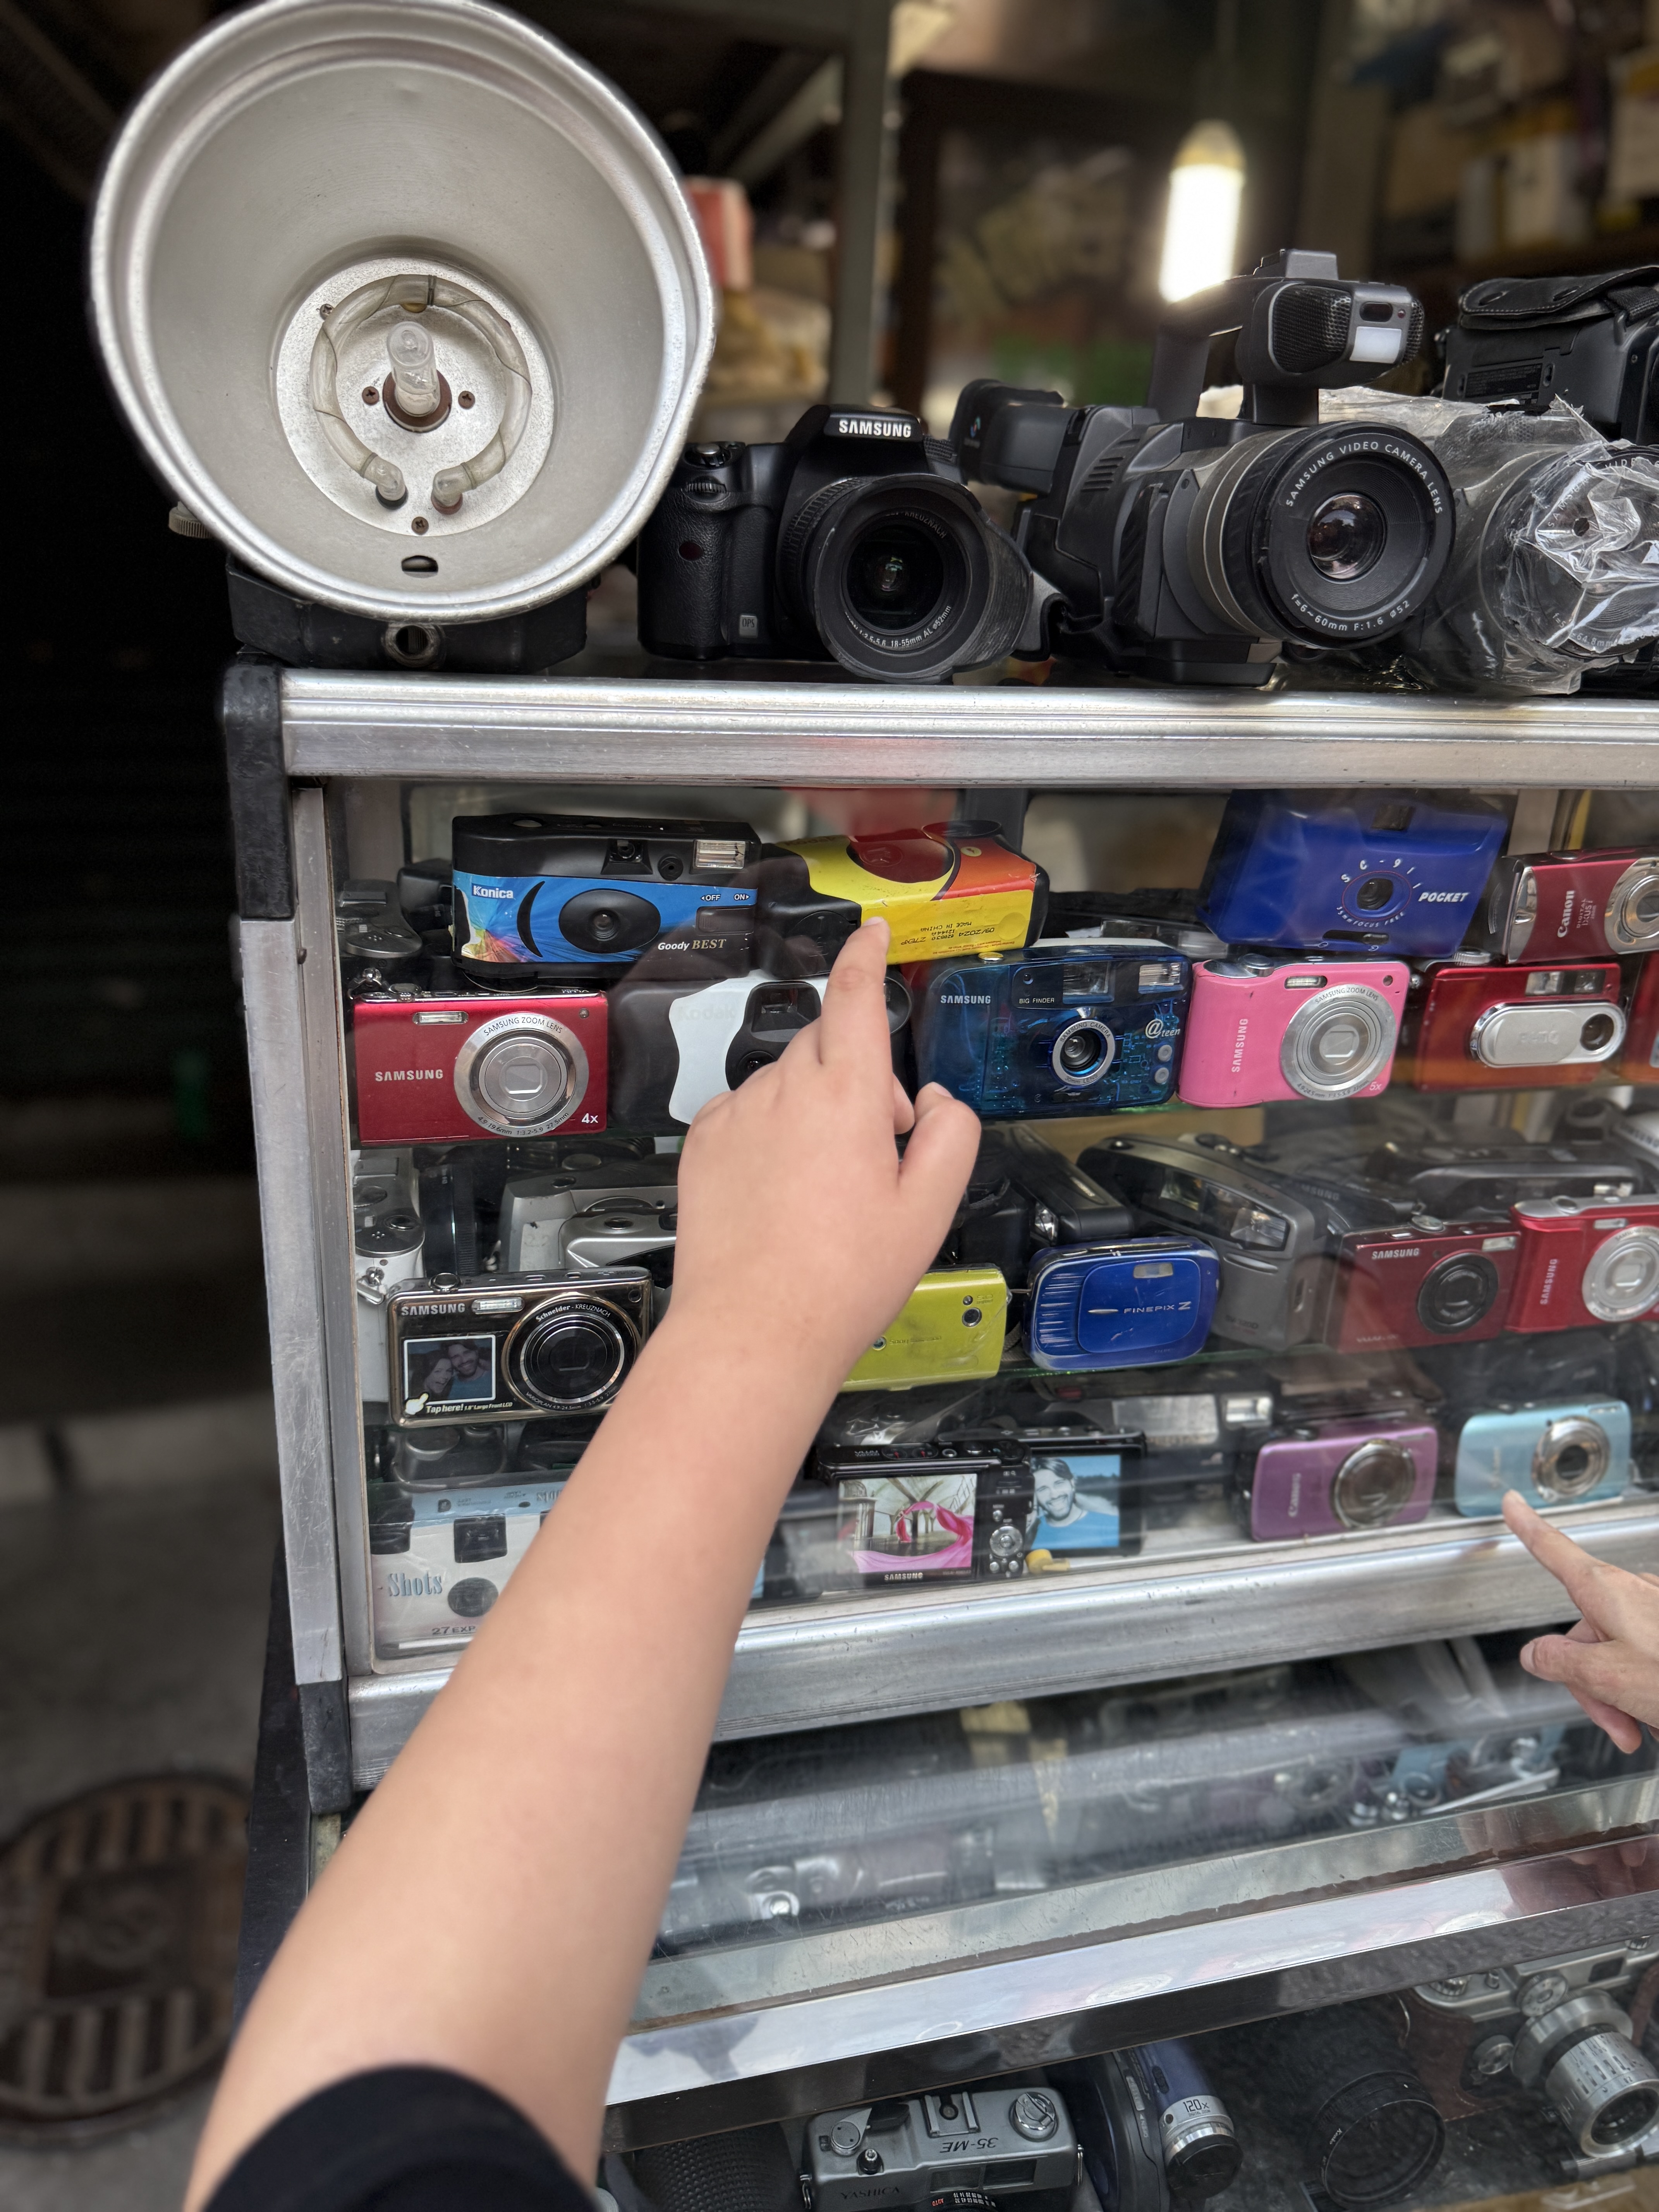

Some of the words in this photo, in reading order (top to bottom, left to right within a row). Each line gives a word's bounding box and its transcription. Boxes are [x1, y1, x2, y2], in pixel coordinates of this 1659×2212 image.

[839, 419, 912, 438] SAMSUNG
[1286, 452, 1334, 507] SAMSUNG
[1339, 441, 1379, 454] VIDEO
[1385, 444, 1428, 479] CAMERA
[1427, 482, 1443, 514] LENS
[742, 618, 755, 628] OPS
[1354, 617, 1384, 631] F:1.6
[891, 635, 922, 647] 18-55mm
[923, 627, 933, 639] AL
[473, 885, 514, 898] Konica
[1419, 892, 1470, 902] POCKET
[1558, 891, 1575, 938] Canon
[658, 942, 690, 951] Goody
[691, 939, 726, 950] BEST
[941, 995, 991, 1004] SAMSUNG
[1315, 988, 1345, 1004] SAMSUNG
[1366, 991, 1379, 1001] LENS
[484, 1017, 519, 1036] SAMSUNG
[522, 1017, 545, 1025] ZOOM
[547, 1021, 563, 1033] LENS
[1060, 1022, 1087, 1042] SAMSUNG
[1091, 1022, 1111, 1038] CAMERA
[1231, 1018, 1248, 1072] SAMSUNG
[375, 1070, 443, 1082] SAMSUNG
[1369, 1082, 1382, 1091] 5x
[546, 1112, 569, 1129] 27.5mm
[581, 1113, 598, 1123] 4x
[1372, 1248, 1419, 1259] SAMSUNG
[1540, 1259, 1558, 1305] SAMSUNG
[401, 1303, 465, 1316] SAMSUNG
[536, 1305, 571, 1322] Schneider
[575, 1303, 611, 1317] KREUZNACH
[1124, 1305, 1175, 1314] FINEPIX
[1178, 1301, 1192, 1310] Z
[426, 1406, 441, 1414] Tap
[441, 1403, 464, 1413] here!
[884, 1572, 923, 1580] SAMSUNG
[388, 1571, 443, 1597] Shots
[432, 1626, 450, 1635] 27
[1183, 2099, 1209, 2113] 120x
[940, 2137, 999, 2153] 35-ME
[841, 2186, 900, 2199] YASHICA
[932, 2198, 944, 2206] AUTO
